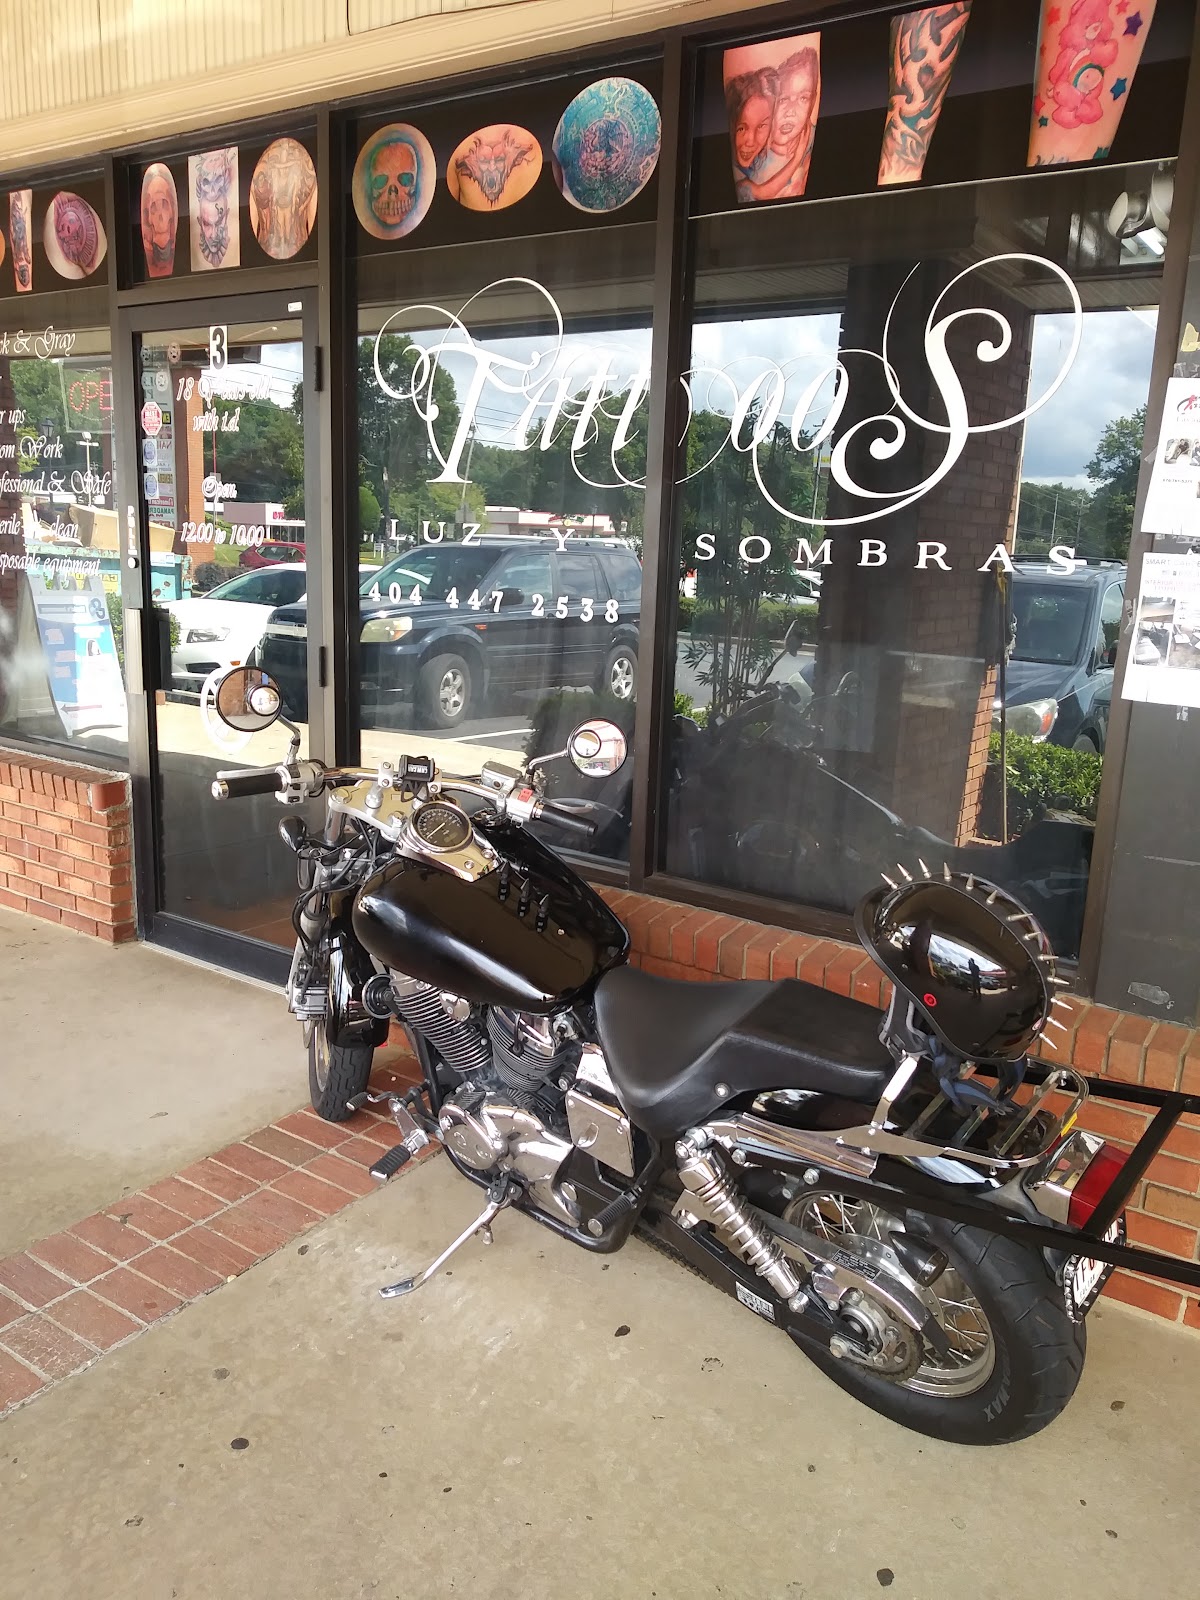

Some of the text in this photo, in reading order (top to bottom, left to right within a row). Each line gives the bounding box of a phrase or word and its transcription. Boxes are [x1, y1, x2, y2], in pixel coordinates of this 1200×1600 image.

[13, 330, 31, 353] &
[35, 325, 76, 359] Gray
[212, 327, 225, 370] 3
[69, 379, 113, 413] OPE
[176, 377, 195, 401] 18
[8, 407, 26, 432] ups
[192, 407, 219, 432] with
[20, 435, 64, 459] Work
[47, 470, 66, 493] &
[390, 519, 1079, 576] LUZ Y SOMBRAS
[43, 554, 101, 587] equipment
[368, 581, 619, 624] 404 447 2538
